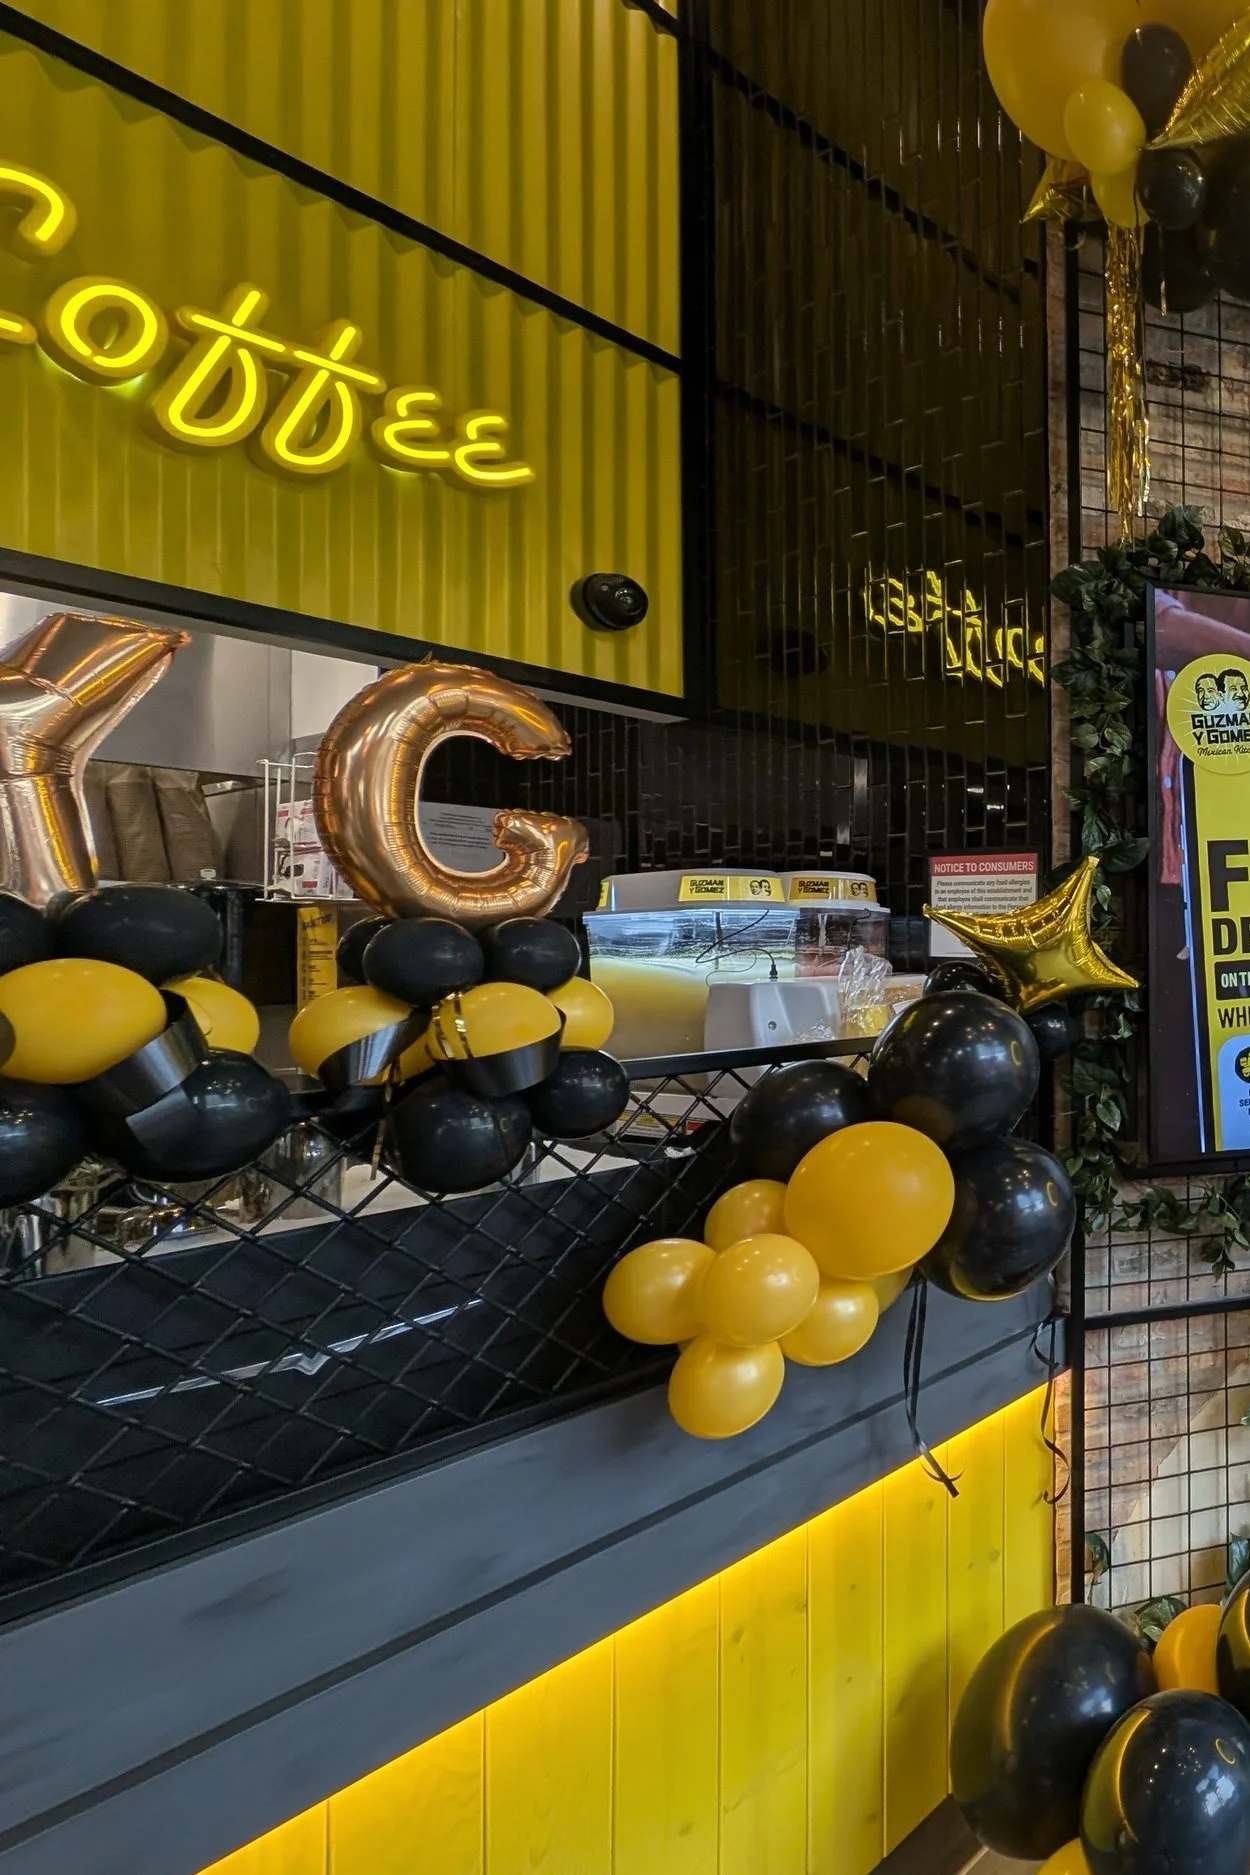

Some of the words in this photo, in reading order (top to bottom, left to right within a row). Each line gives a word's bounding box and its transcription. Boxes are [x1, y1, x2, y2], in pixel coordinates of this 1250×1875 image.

[1192, 731, 1204, 745] Y
[1197, 747, 1233, 756] Mexican
[935, 863, 964, 873] NOTICE
[965, 862, 977, 872] TO
[979, 861, 1034, 872] CONSUMERS
[1008, 879, 1031, 887] allergies
[1220, 973, 1238, 988] ON
